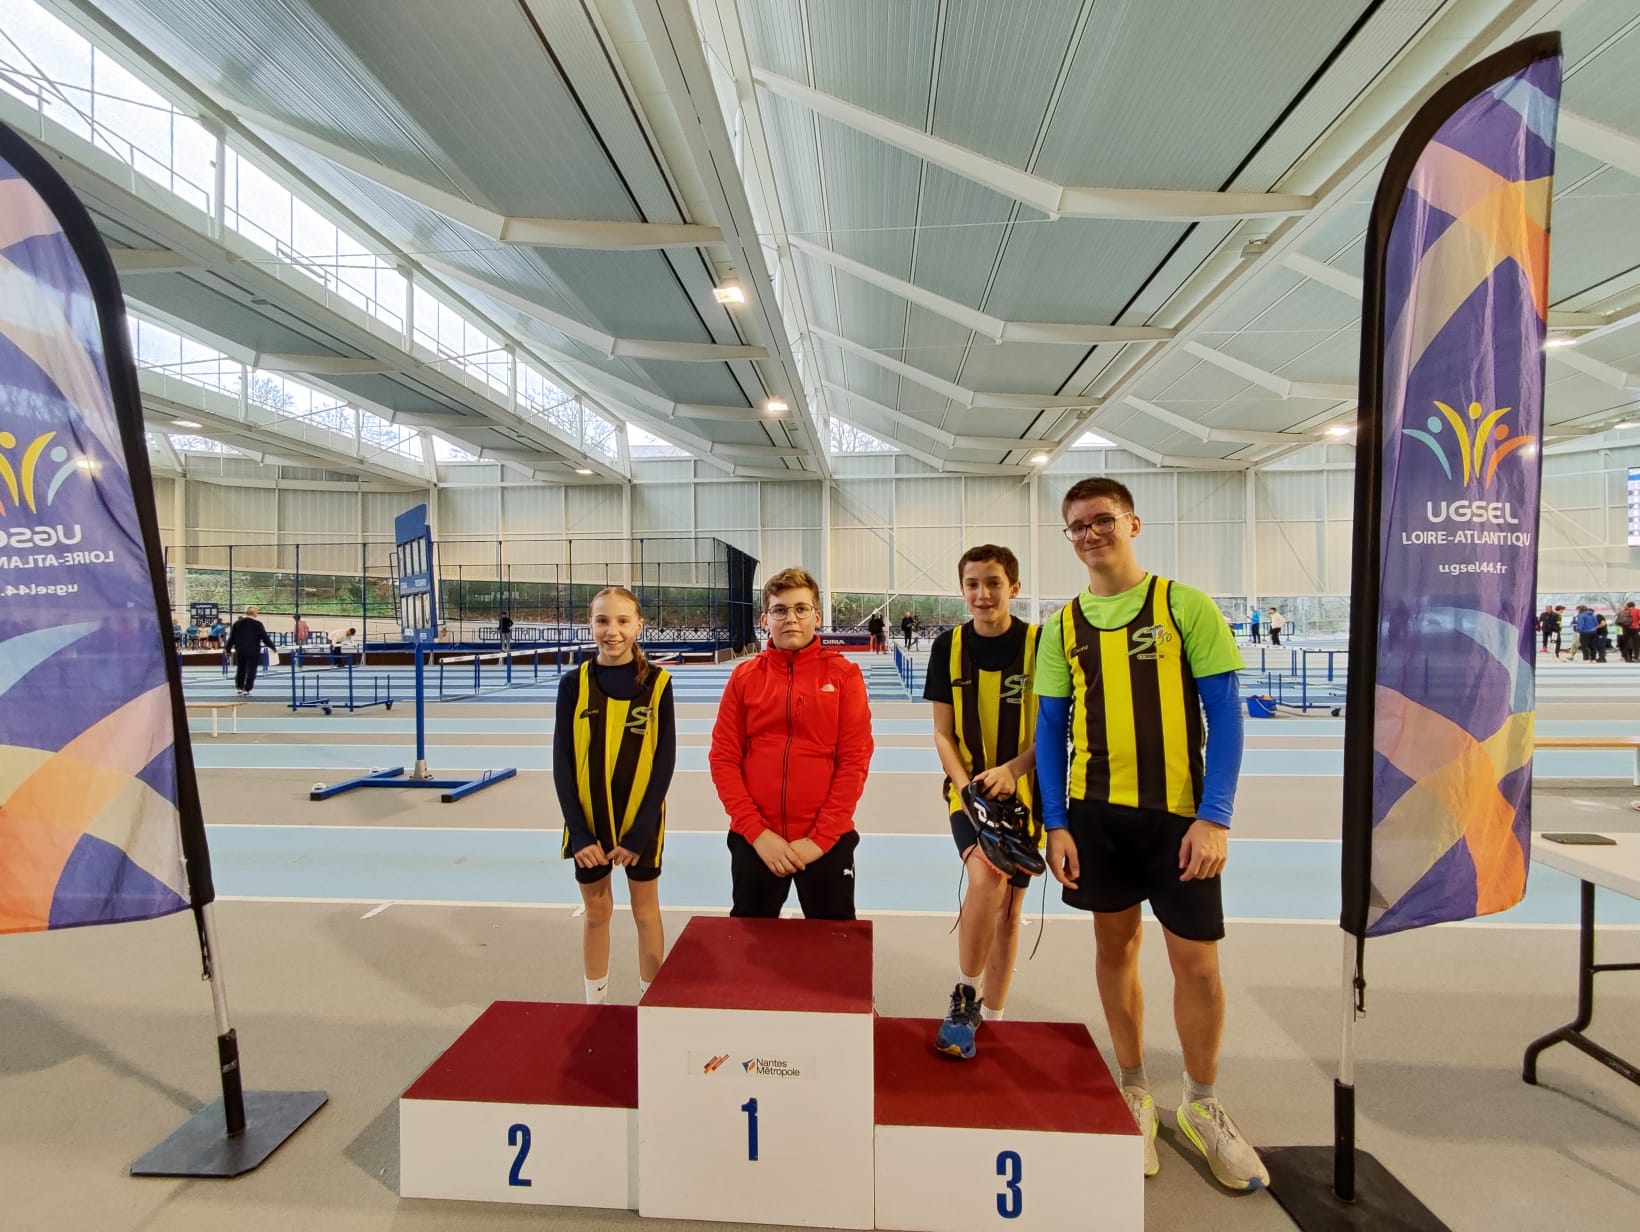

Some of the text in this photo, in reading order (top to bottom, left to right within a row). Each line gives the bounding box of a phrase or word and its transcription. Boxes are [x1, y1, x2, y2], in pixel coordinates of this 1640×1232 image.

[1426, 500, 1519, 524] UGSEL
[1439, 561, 1508, 575] ugsel44.fr
[756, 1058, 788, 1068] Nantes
[756, 1066, 801, 1078] Métropole
[741, 1097, 759, 1161] 1
[507, 1123, 532, 1187] 2
[996, 1150, 1022, 1219] 3
